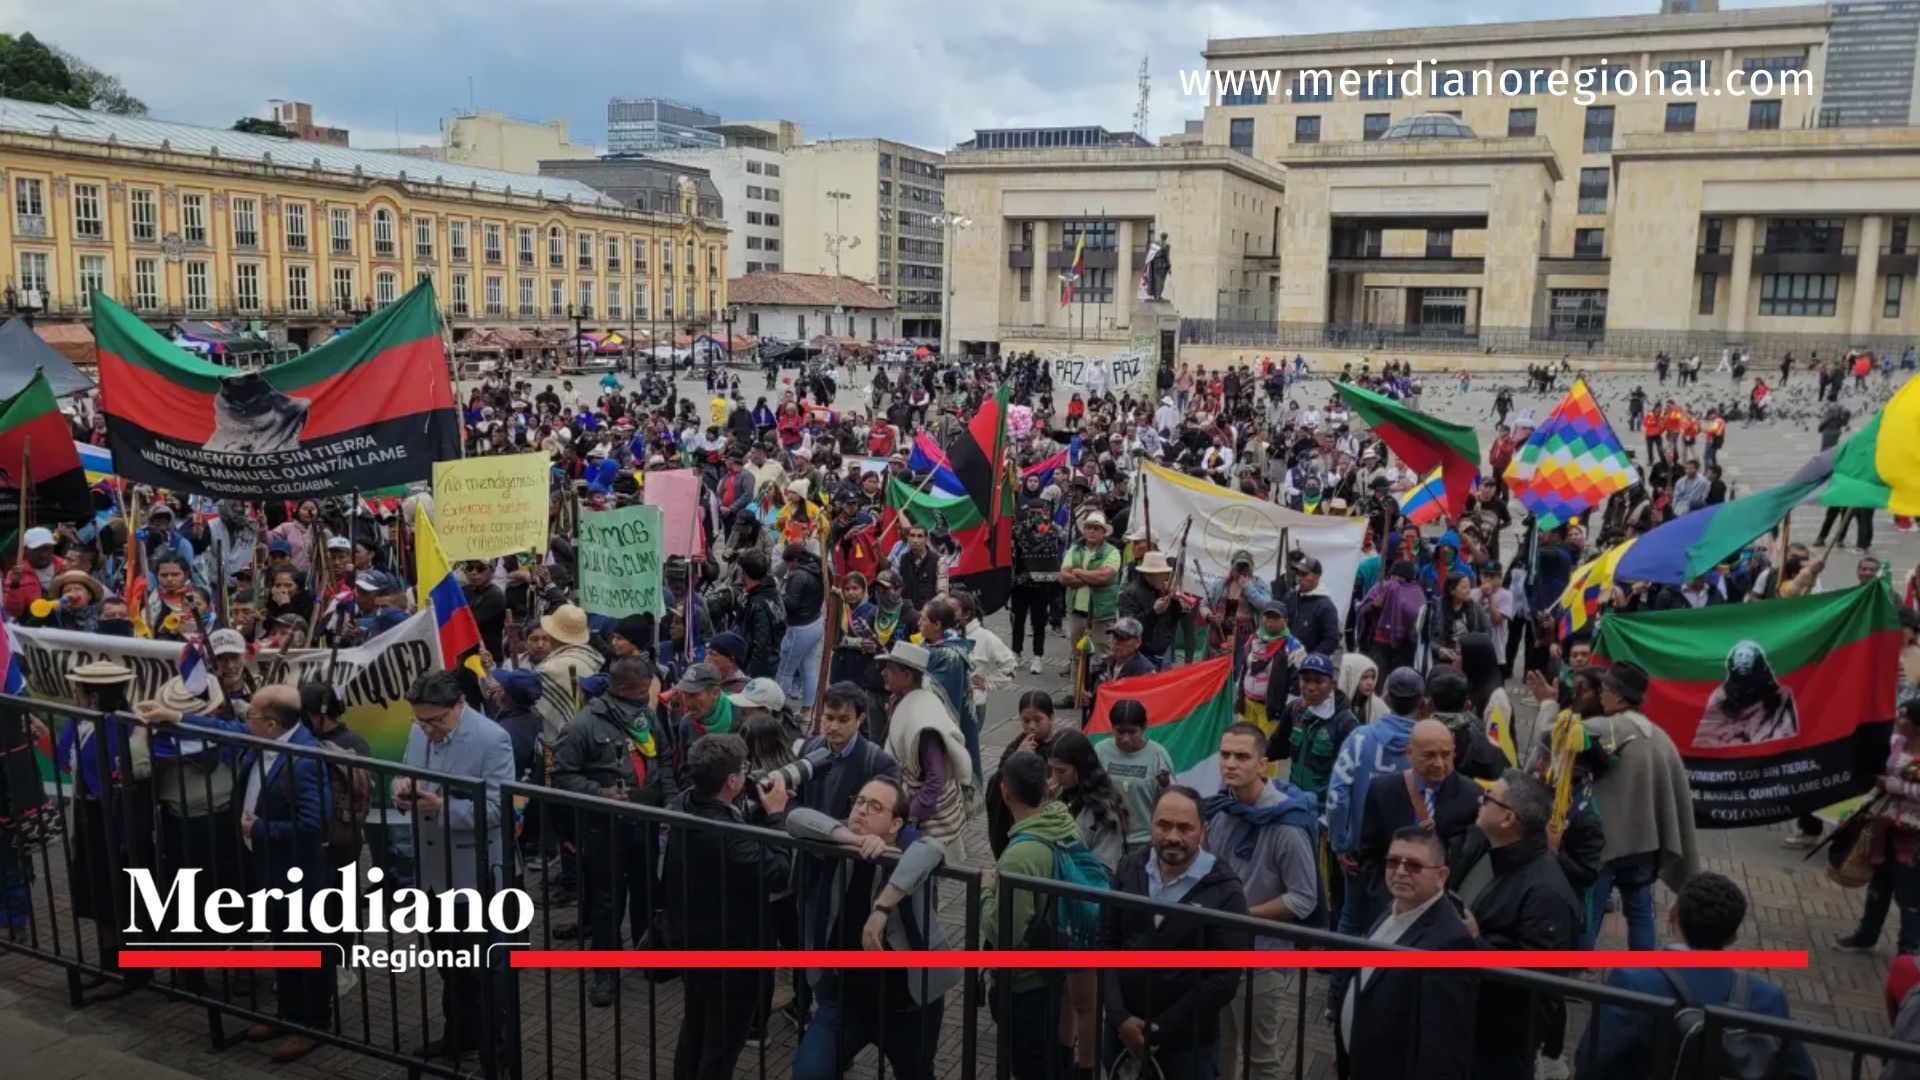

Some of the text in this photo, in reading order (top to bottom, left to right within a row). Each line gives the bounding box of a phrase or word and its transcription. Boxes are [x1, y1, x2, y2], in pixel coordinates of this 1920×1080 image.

[1055, 360, 1084, 385] PAZ
[1113, 357, 1140, 384] PAZ
[140, 445, 408, 481] NIETOS DE MANUEL QUINTÍN LAME
[154, 434, 377, 467] MOVIMIENTO LOS SIN TIERRA
[1791, 778, 1821, 794] LAME
[1710, 805, 1792, 821] COLOMBIA
